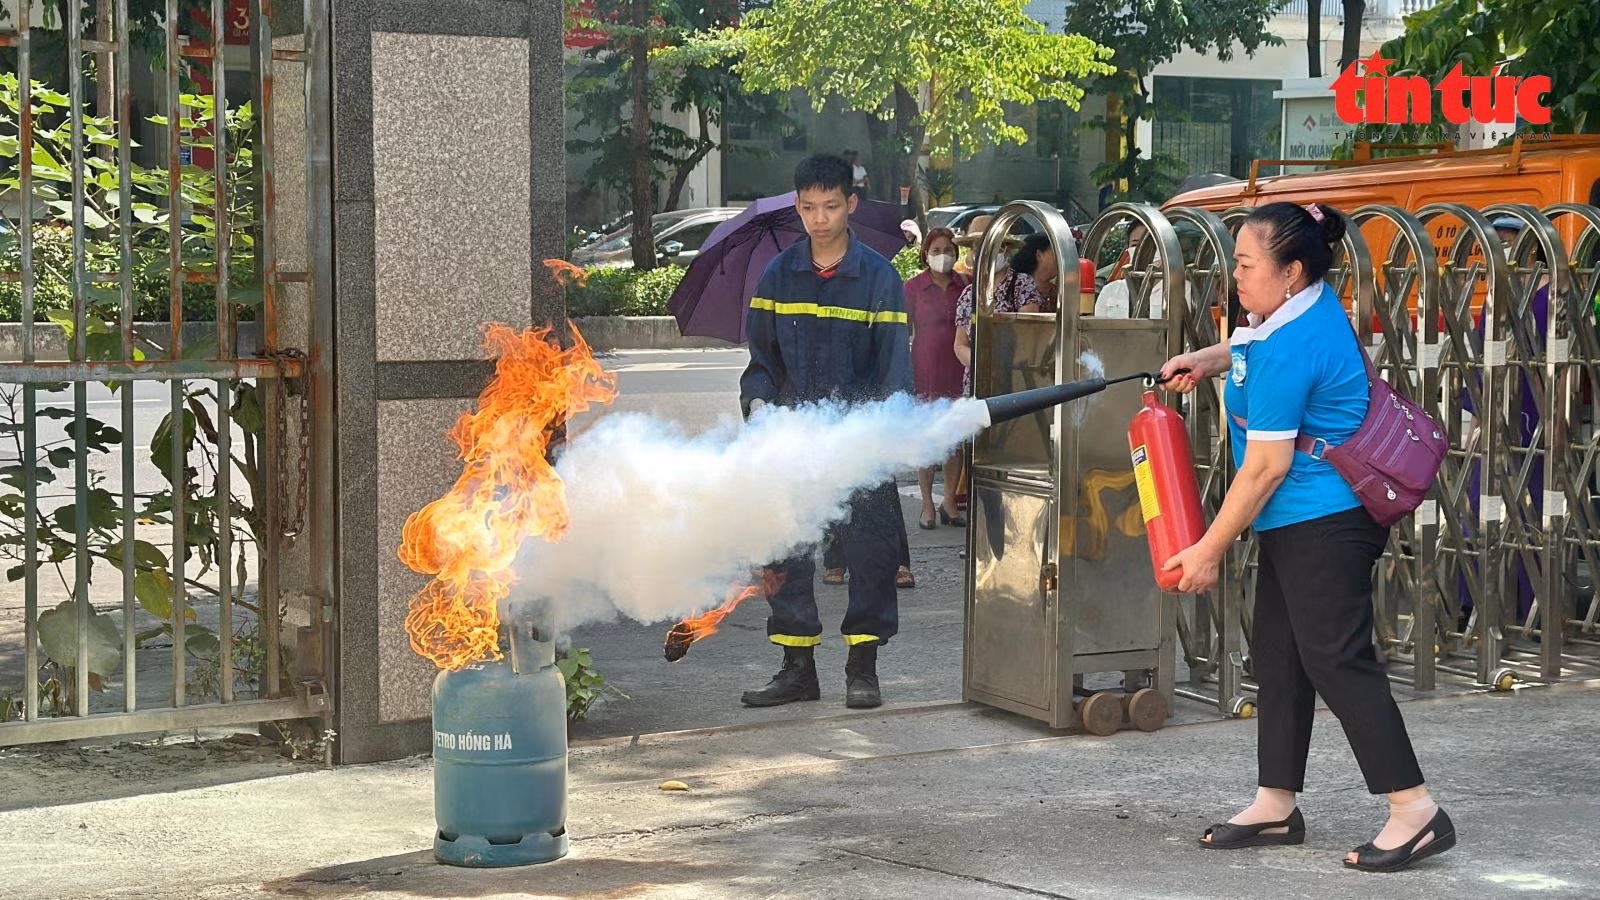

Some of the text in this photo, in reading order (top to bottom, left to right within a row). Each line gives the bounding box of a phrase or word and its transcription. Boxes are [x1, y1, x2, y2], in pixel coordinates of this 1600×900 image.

[1308, 139, 1332, 159] QUẢN
[434, 729, 456, 750] PETRO
[458, 729, 491, 751] HỒNG
